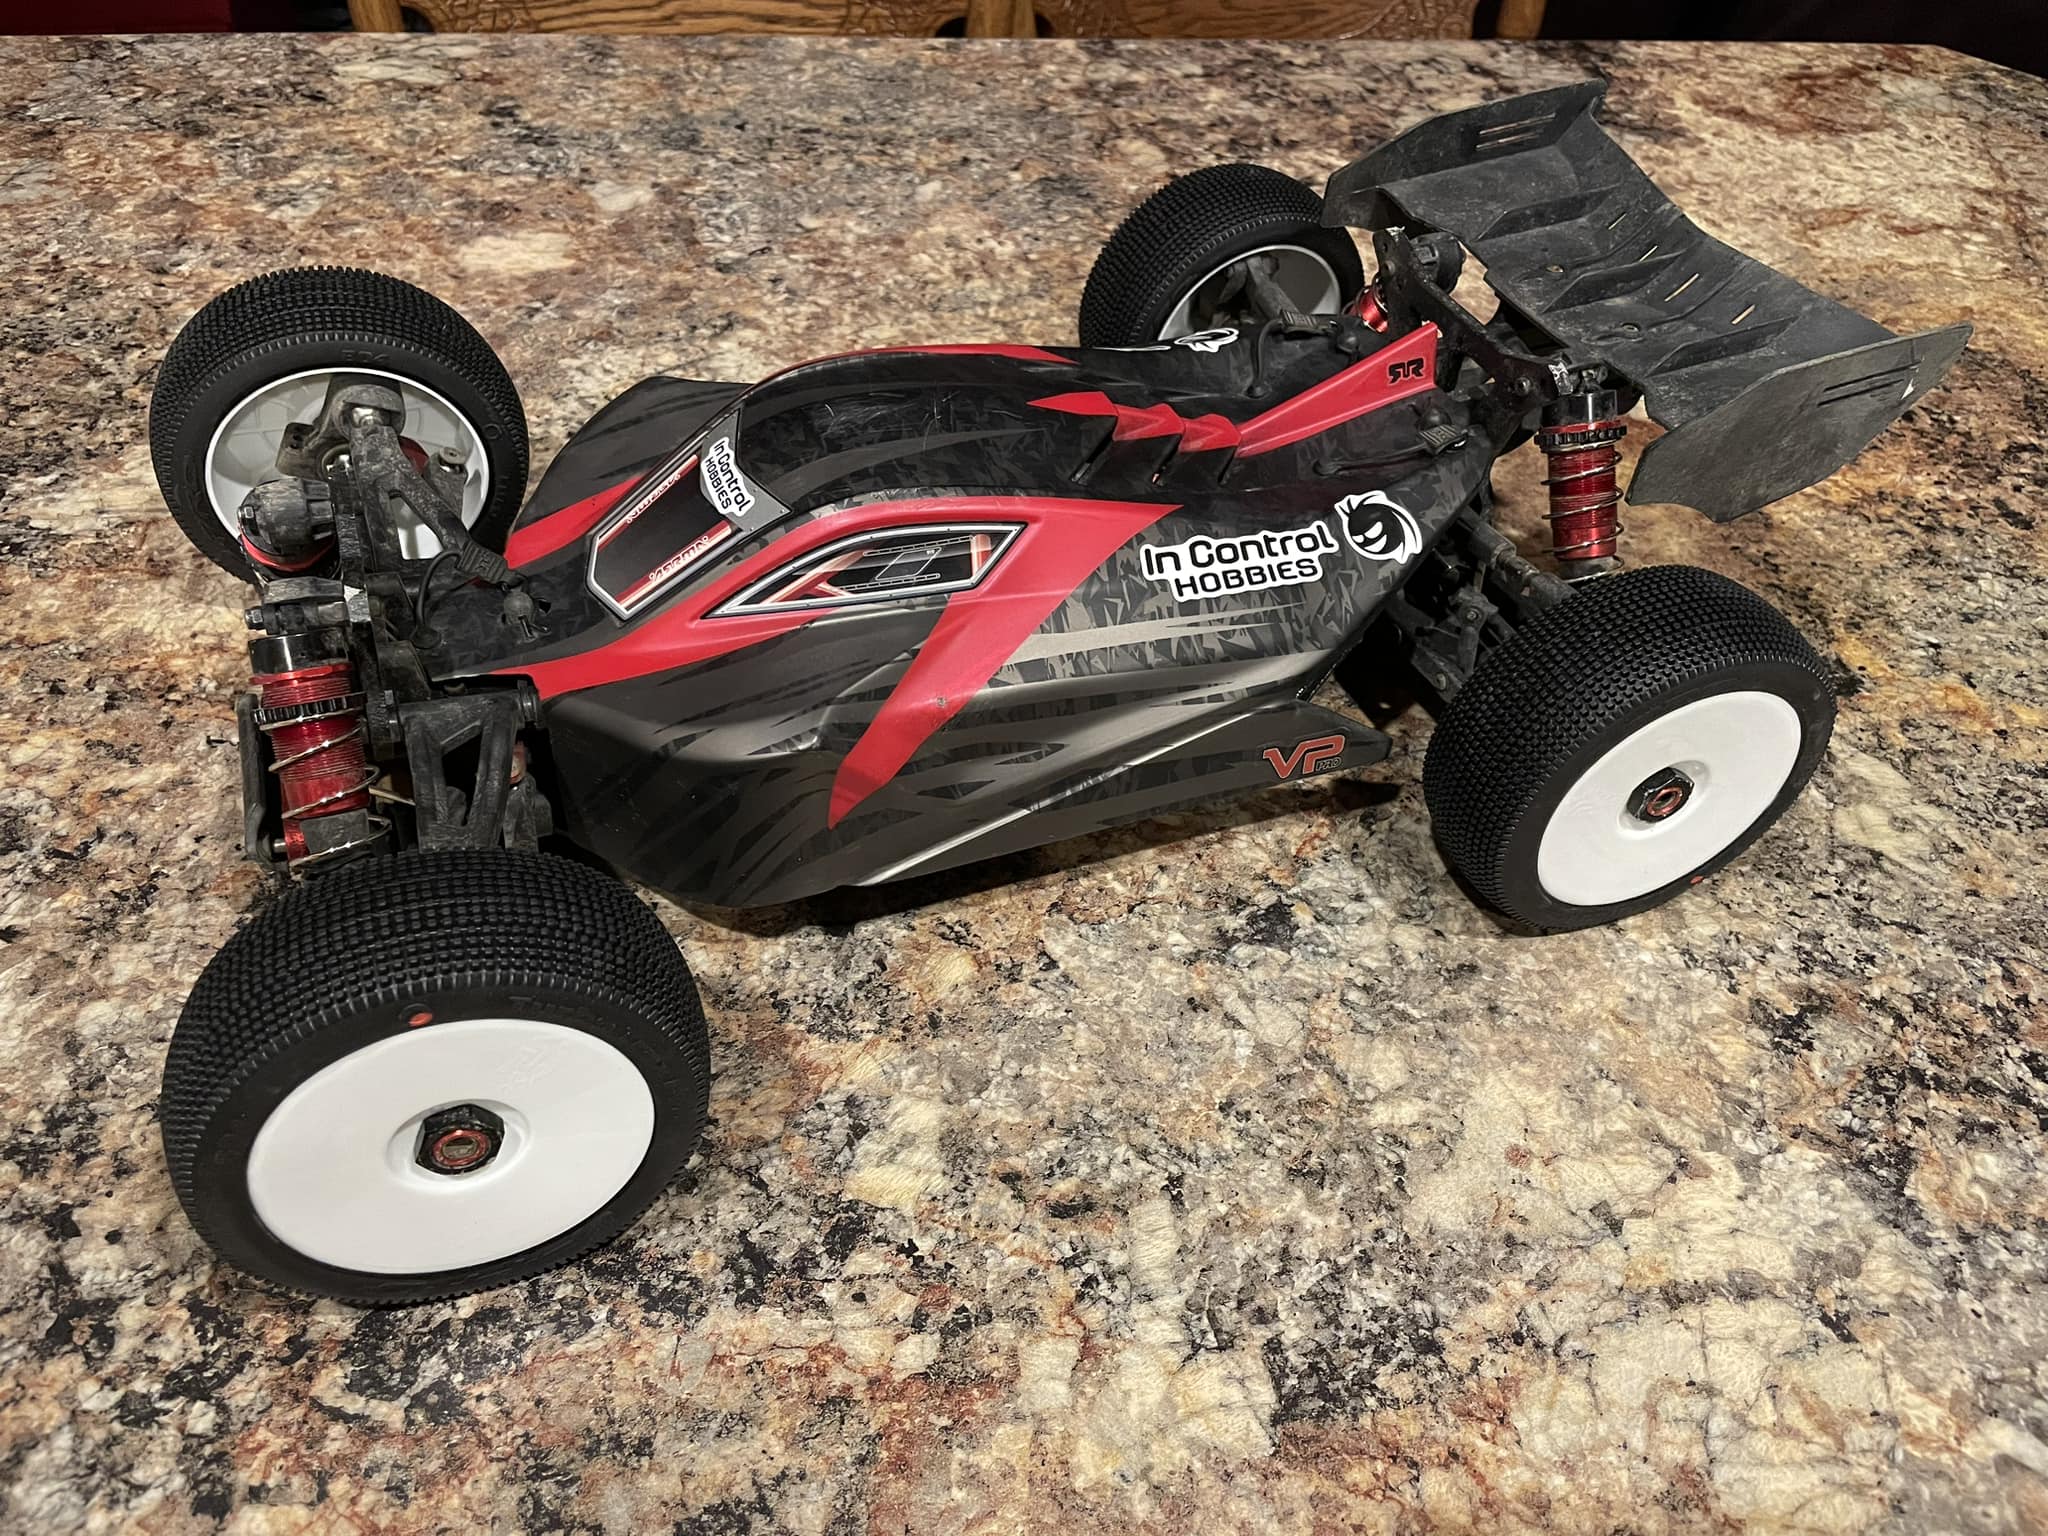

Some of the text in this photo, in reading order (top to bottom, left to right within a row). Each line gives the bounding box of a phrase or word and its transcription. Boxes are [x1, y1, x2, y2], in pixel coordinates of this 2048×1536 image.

[704, 458, 733, 510] HOBBIES
[713, 440, 751, 512] In Control
[1144, 525, 1335, 576] In Control
[1175, 558, 1319, 597] HOBBIES
[1262, 734, 1345, 779] VP
[1315, 757, 1342, 772] PRO
